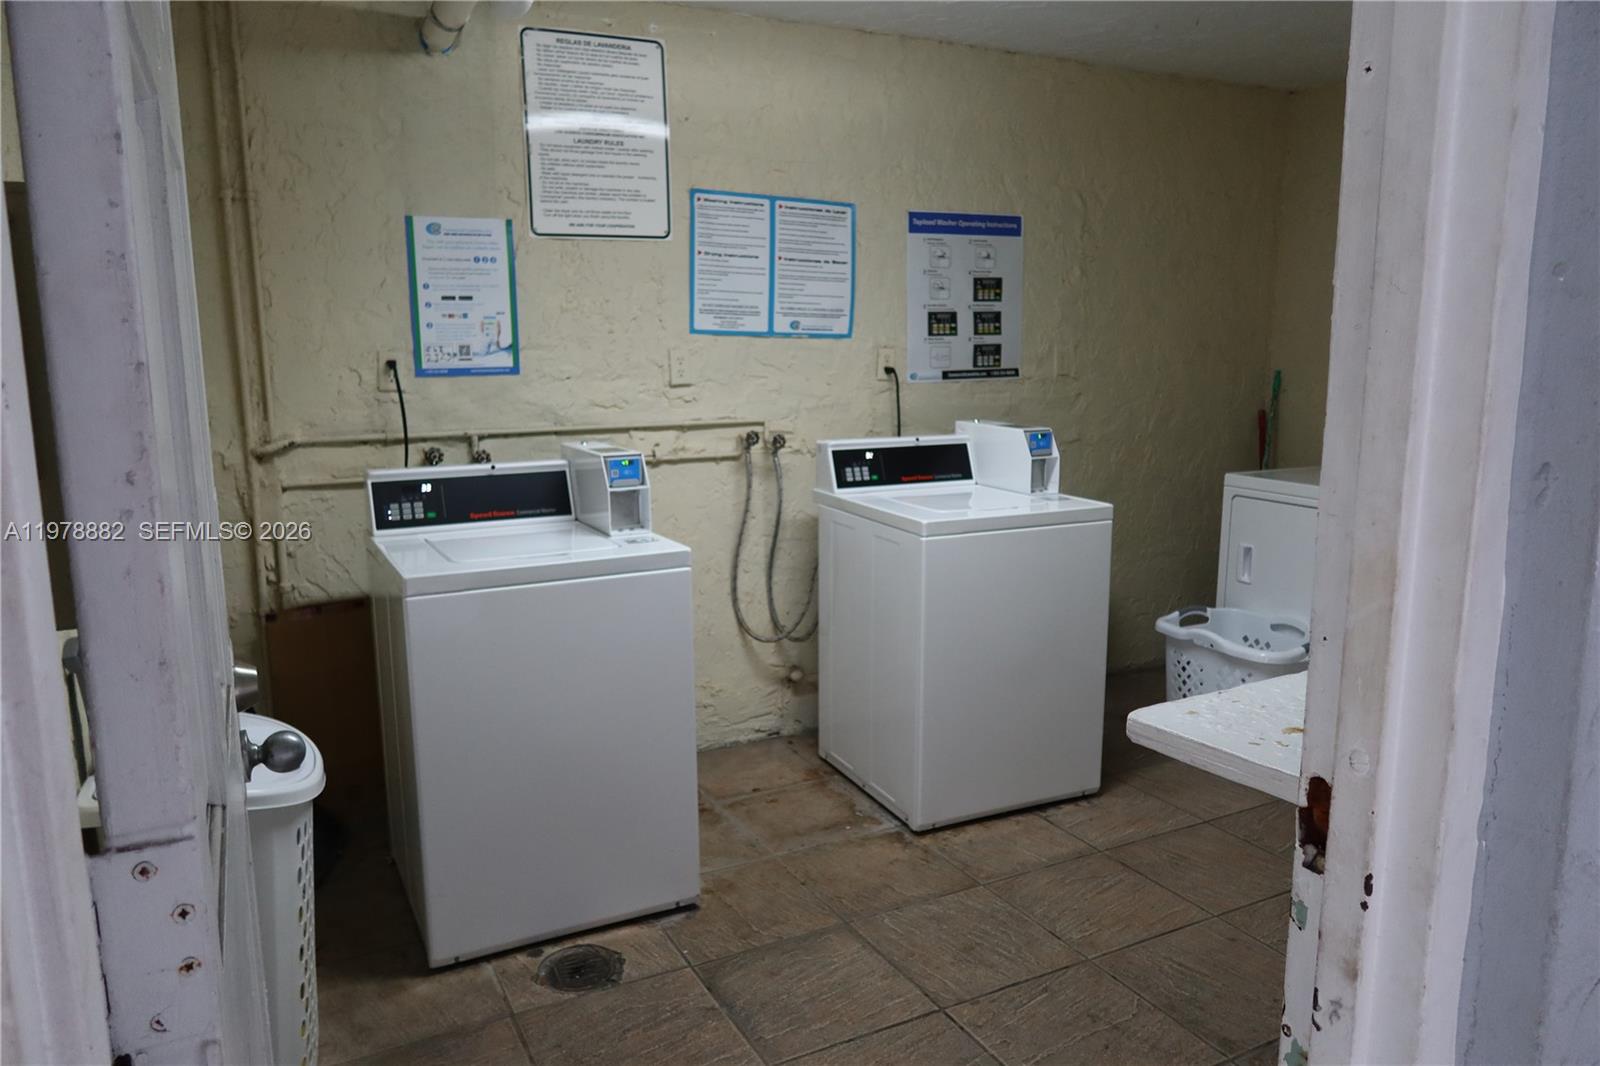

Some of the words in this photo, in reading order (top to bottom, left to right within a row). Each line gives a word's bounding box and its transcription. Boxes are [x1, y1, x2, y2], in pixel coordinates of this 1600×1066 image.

[555, 38, 582, 46] REGLAS
[604, 139, 625, 147] RULES
[729, 199, 765, 207] Instructions
[912, 218, 936, 227] Topload
[937, 219, 957, 227] Washer
[958, 220, 986, 229] Operating
[986, 221, 1018, 229] Instructions
[469, 510, 492, 520] Speed
[493, 509, 515, 519] Queen
